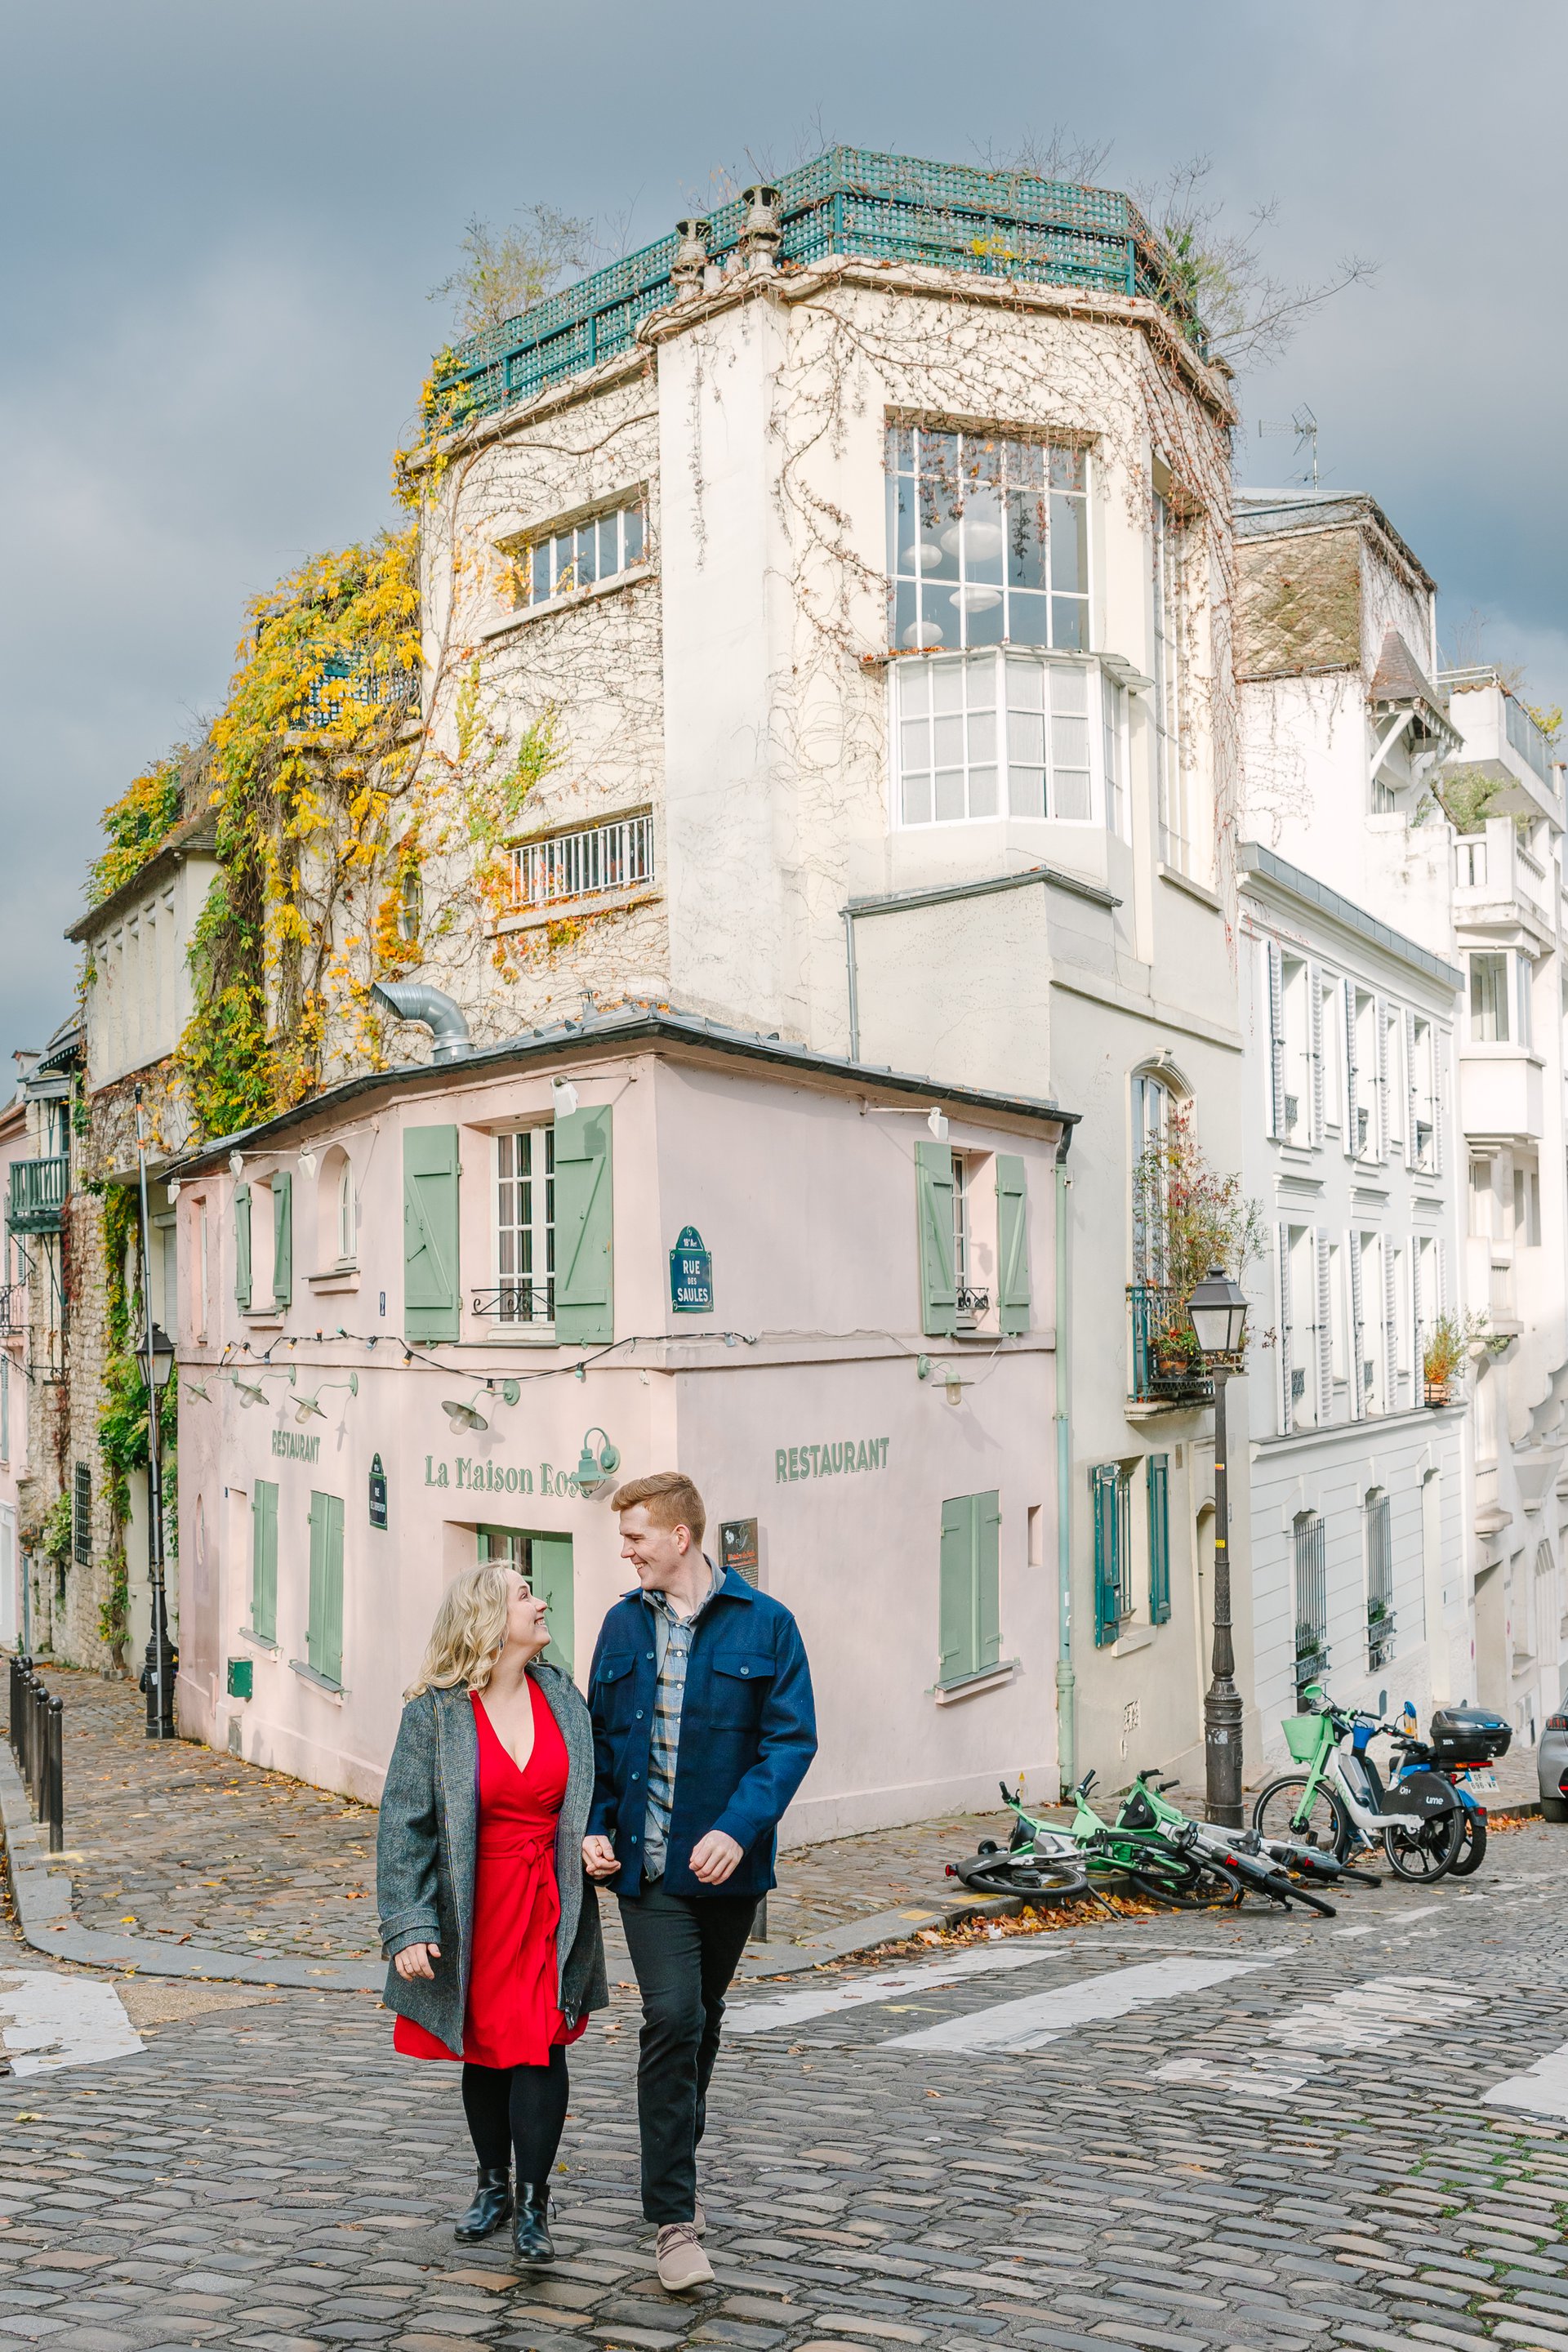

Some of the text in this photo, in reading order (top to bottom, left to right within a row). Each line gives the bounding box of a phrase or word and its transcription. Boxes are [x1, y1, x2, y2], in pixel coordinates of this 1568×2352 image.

[683, 1259, 701, 1275] RUE
[687, 1276, 697, 1285] DES
[677, 1288, 709, 1303] SAULES
[272, 1429, 321, 1464] RESTAURANT
[775, 1437, 890, 1483] RESTAURANT
[424, 1455, 450, 1489] La
[455, 1457, 534, 1494] Maison
